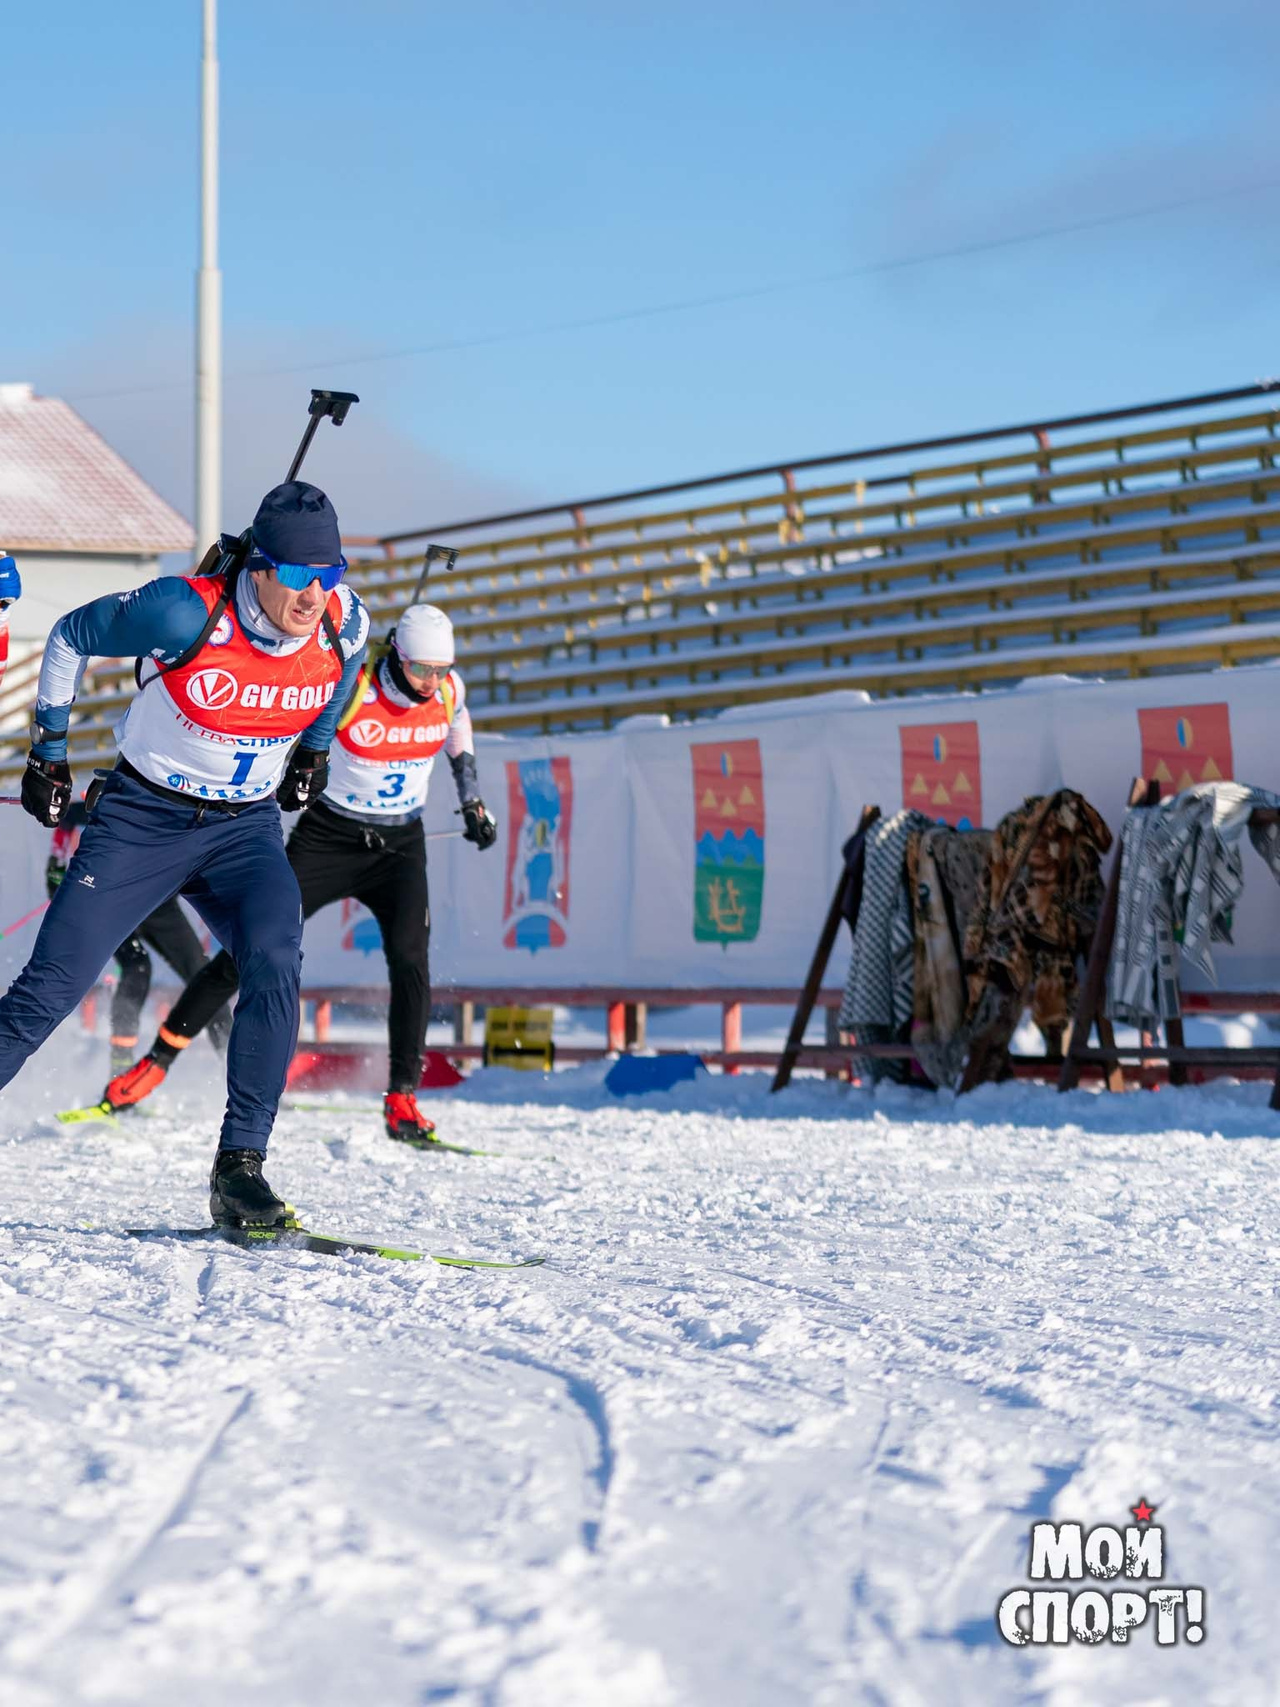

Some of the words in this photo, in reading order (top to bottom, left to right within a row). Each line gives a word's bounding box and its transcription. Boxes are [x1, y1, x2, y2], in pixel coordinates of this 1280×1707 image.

[240, 683, 279, 708] GV
[281, 681, 335, 710] GOLD
[387, 727, 412, 743] GV
[414, 723, 448, 743] GOLD
[228, 751, 258, 786] 1
[378, 774, 405, 798] 3
